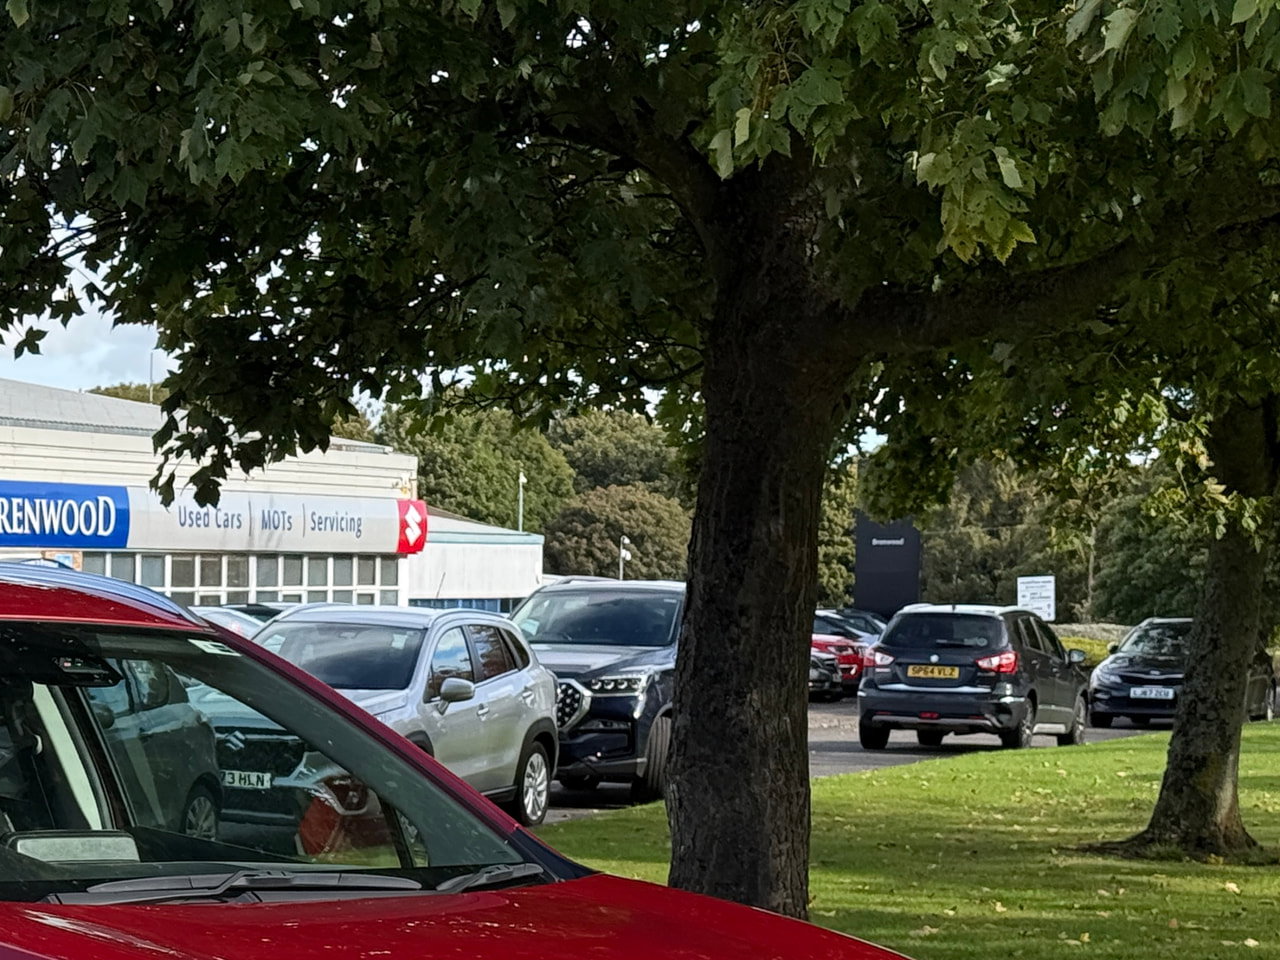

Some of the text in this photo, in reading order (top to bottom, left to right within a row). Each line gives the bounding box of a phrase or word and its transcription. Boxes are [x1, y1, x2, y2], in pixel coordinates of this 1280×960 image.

[178, 505, 362, 539] Used Cars MOTs Servicing
[238, 772, 265, 787] HLN
